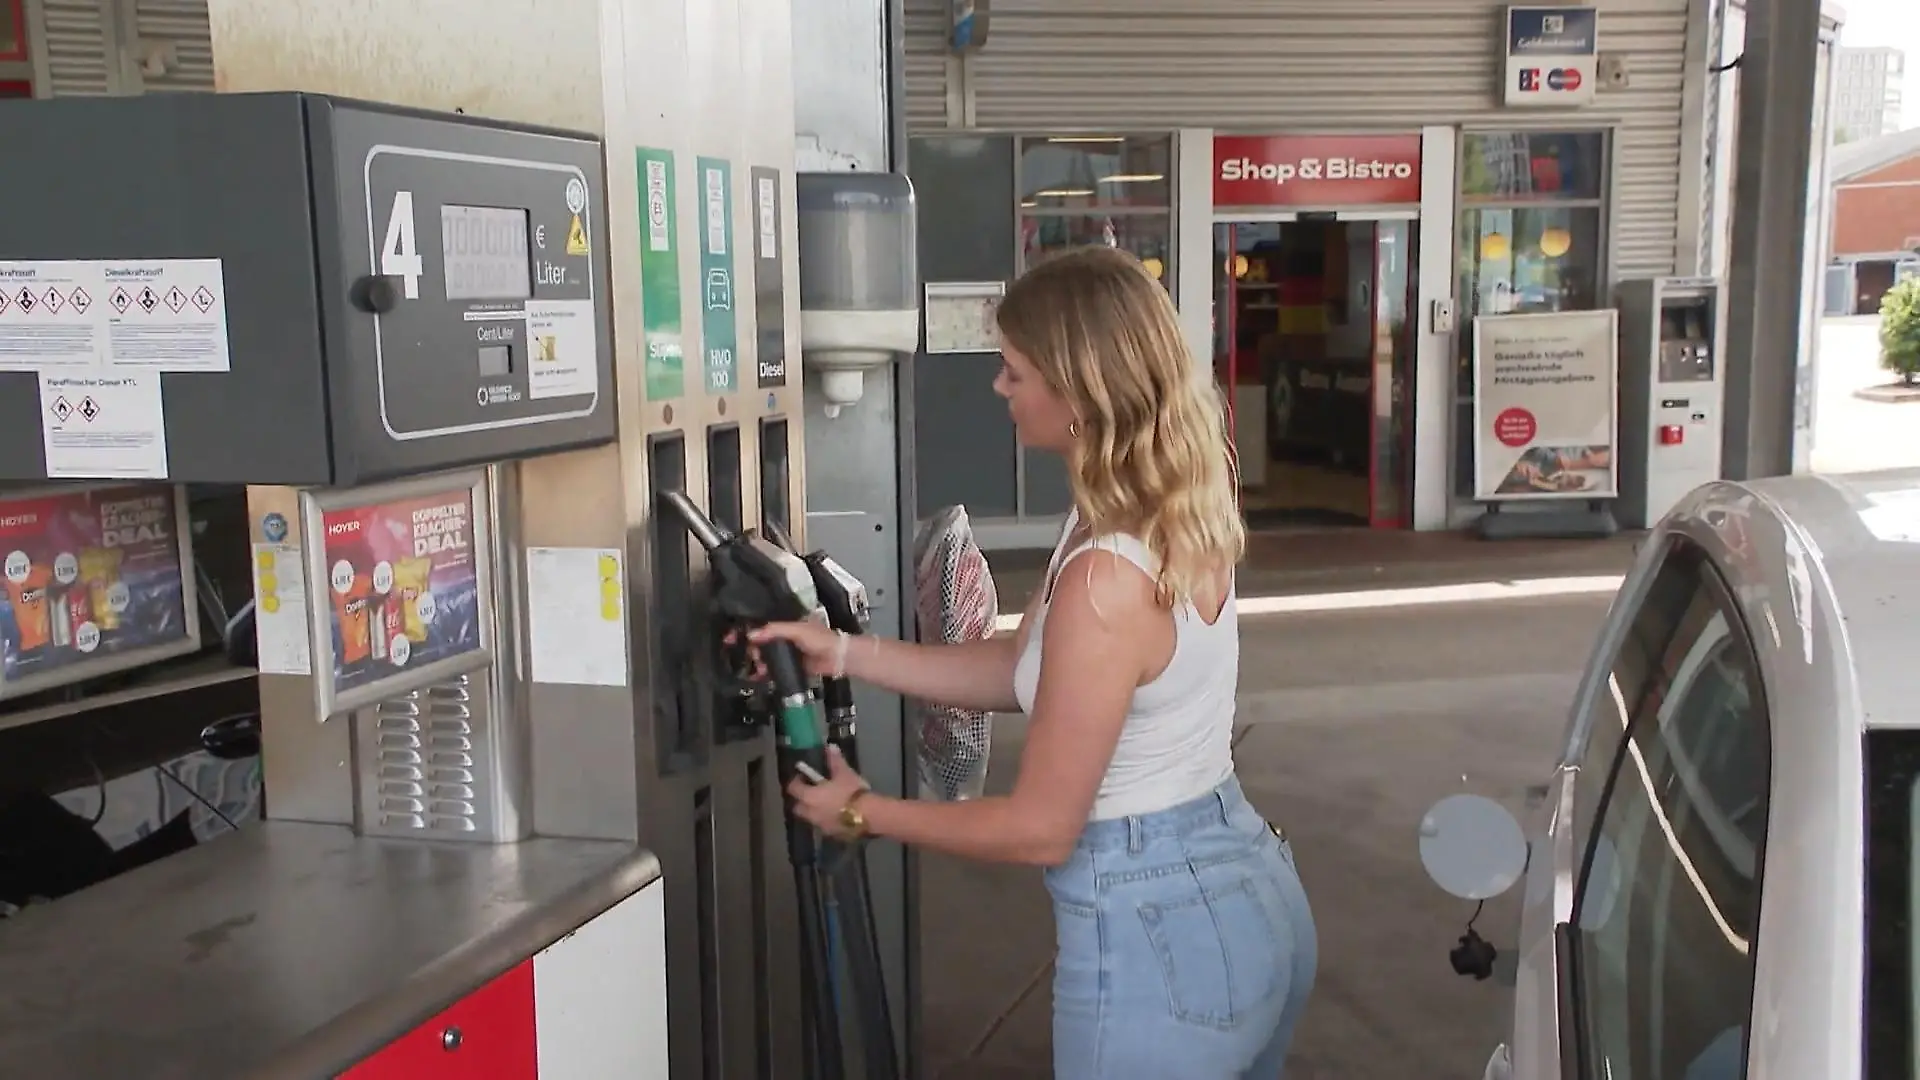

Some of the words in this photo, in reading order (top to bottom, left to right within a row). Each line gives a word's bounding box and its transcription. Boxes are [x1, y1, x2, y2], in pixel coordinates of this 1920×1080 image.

[1221, 157, 1295, 185] Shop
[1298, 157, 1322, 179] &
[1326, 157, 1412, 179] Bistro
[381, 191, 423, 300] 4
[535, 225, 546, 249] €
[536, 261, 566, 285] Liter
[711, 349, 732, 365] HVO
[712, 371, 729, 387] 100
[759, 361, 785, 378] Diesel
[103, 524, 168, 547] DEAL
[328, 520, 361, 537] HOYER
[414, 531, 468, 558] DEAL
